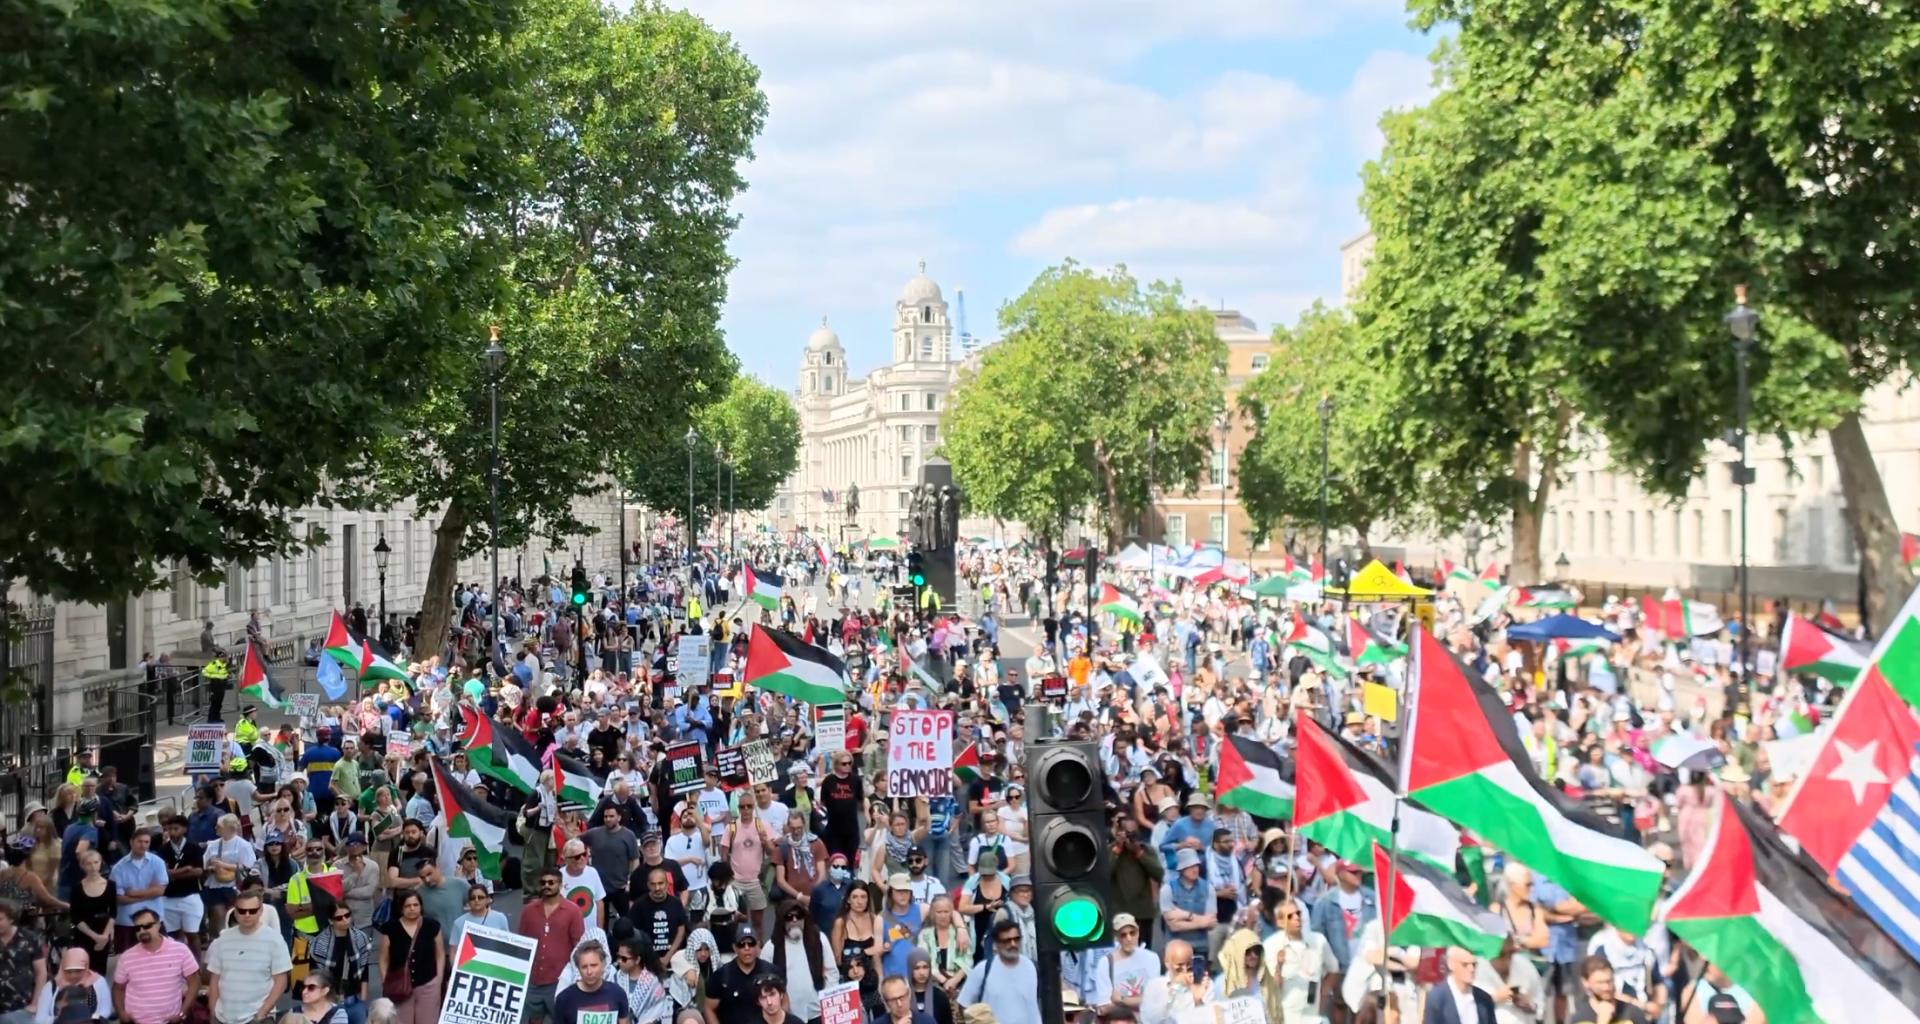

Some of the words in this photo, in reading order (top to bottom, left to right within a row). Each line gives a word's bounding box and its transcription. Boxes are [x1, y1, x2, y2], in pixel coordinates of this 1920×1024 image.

[188, 730, 224, 740] SANCTION
[896, 716, 950, 741] STOP
[193, 740, 217, 751] ISRAEL
[907, 742, 937, 762] THE
[673, 756, 697, 771] ISRAEL
[748, 750, 773, 767] WILL
[749, 762, 775, 783] YOU?
[889, 767, 952, 796] GENOCIDE
[450, 971, 523, 1013] FREE
[446, 999, 517, 1024] PALESTINE
[583, 1013, 613, 1024] GAZA
